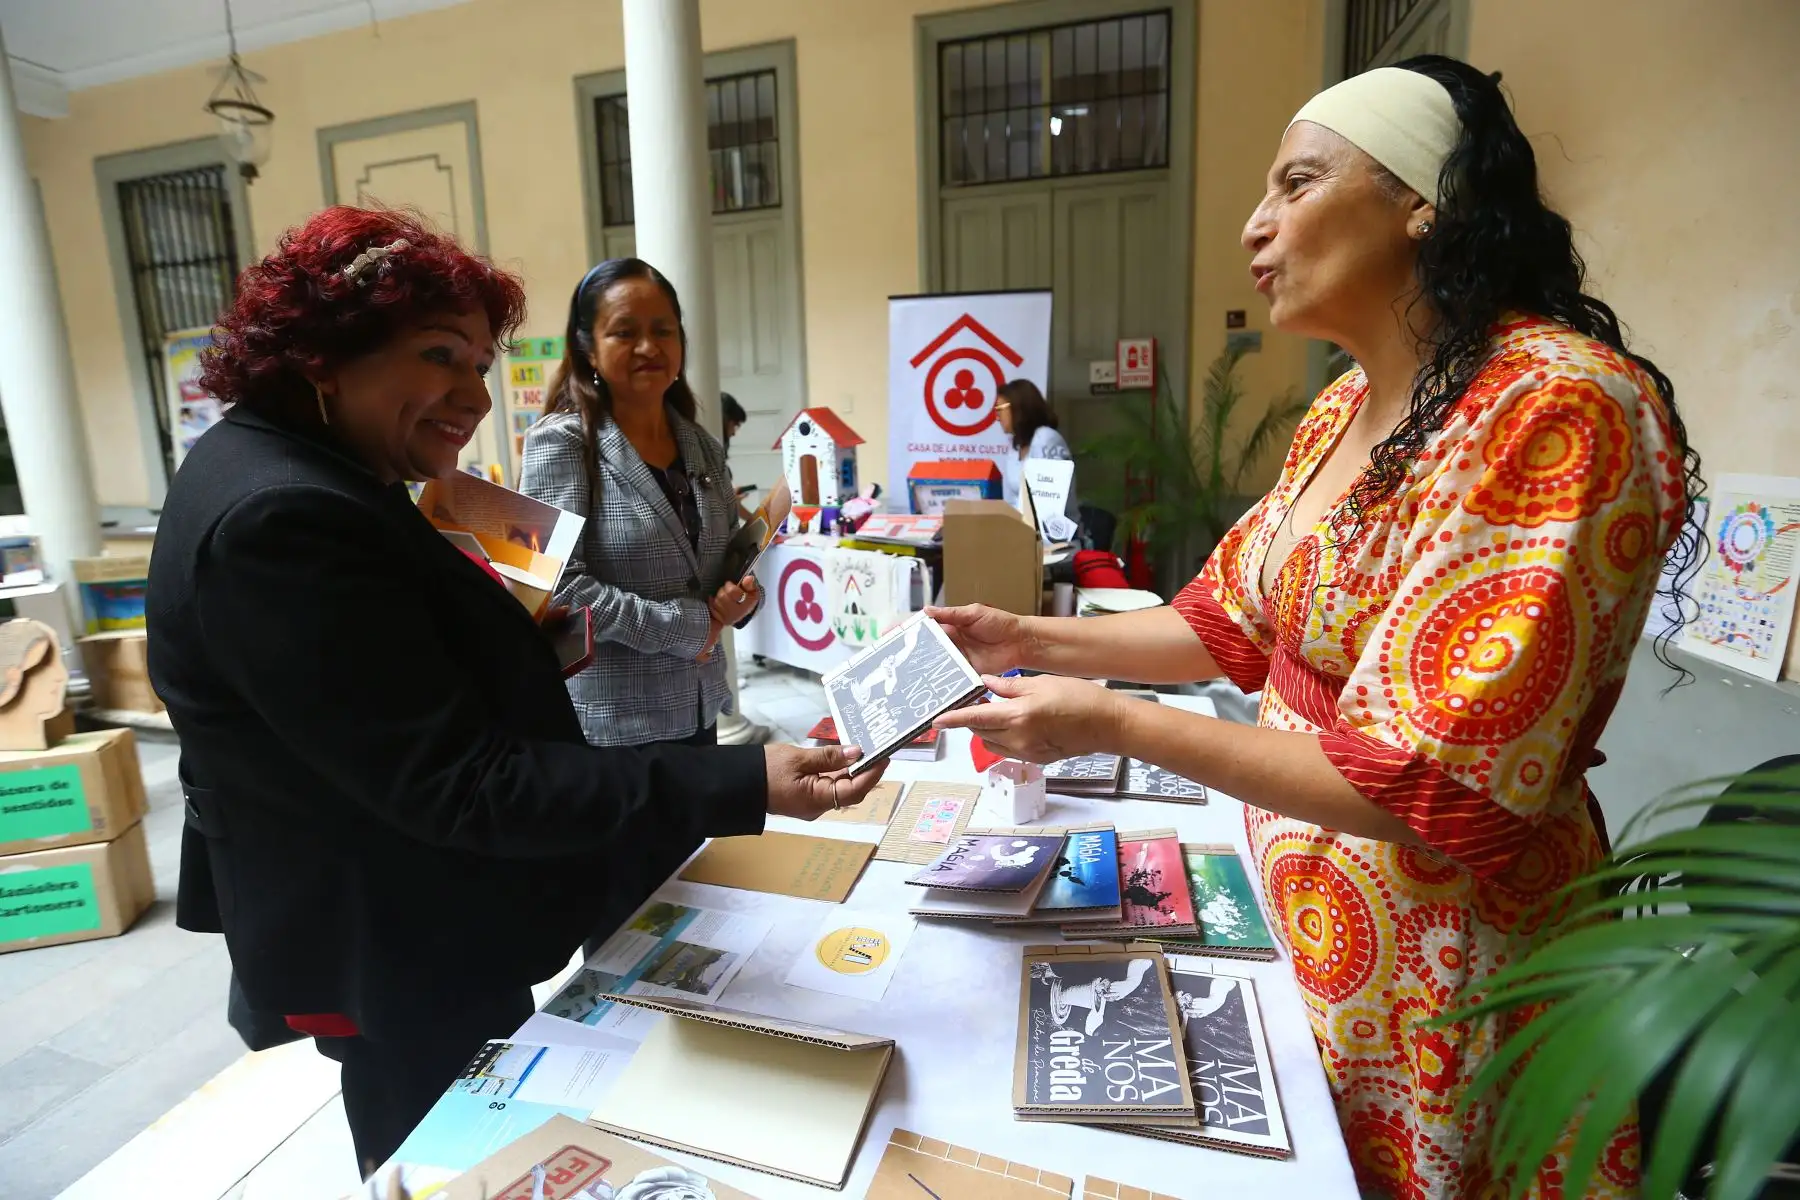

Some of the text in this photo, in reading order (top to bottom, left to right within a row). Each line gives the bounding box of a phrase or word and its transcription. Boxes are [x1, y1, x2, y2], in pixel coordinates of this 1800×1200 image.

[907, 443, 930, 453] CASA
[932, 443, 944, 453] DE
[946, 444, 958, 454] LA
[959, 444, 977, 454] PAX
[924, 656, 968, 703] MA
[901, 676, 939, 718] NOS
[1071, 760, 1090, 778] NOS
[1090, 760, 1115, 778] MA
[1159, 773, 1179, 796] NOS
[931, 838, 981, 872] MAGIA
[0, 898, 86, 918] artonera
[1049, 1030, 1087, 1102] Greda
[1082, 1058, 1101, 1074] de
[1102, 1039, 1139, 1102] NOS
[1134, 1036, 1181, 1103] MA
[1218, 1059, 1268, 1128] MA
